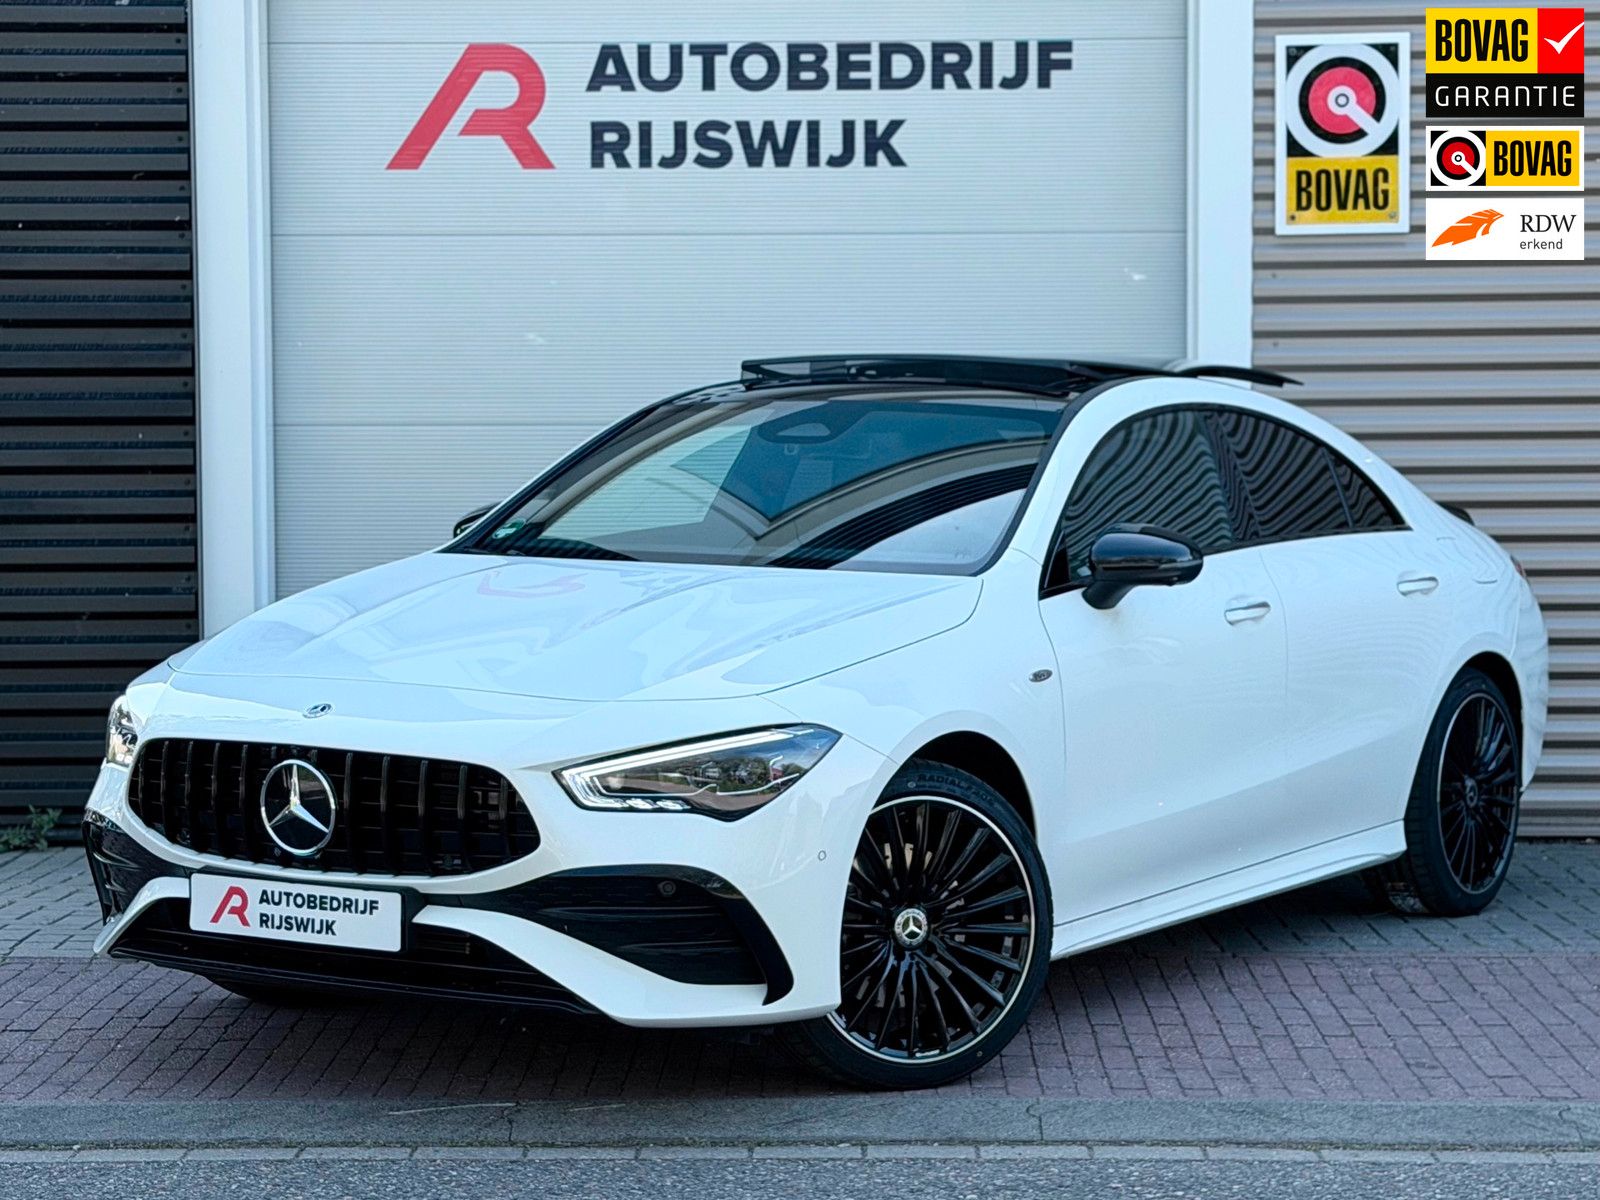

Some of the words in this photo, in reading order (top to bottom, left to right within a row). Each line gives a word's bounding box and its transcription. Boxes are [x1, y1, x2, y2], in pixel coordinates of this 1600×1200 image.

[586, 40, 1073, 92] AUTOBEDRIJF
[590, 119, 907, 169] RIJSWIJK
[1295, 167, 1390, 212] BOVAG
[258, 889, 380, 916] AUTOBEDRIJF
[258, 912, 337, 936] RIJSWIJK
